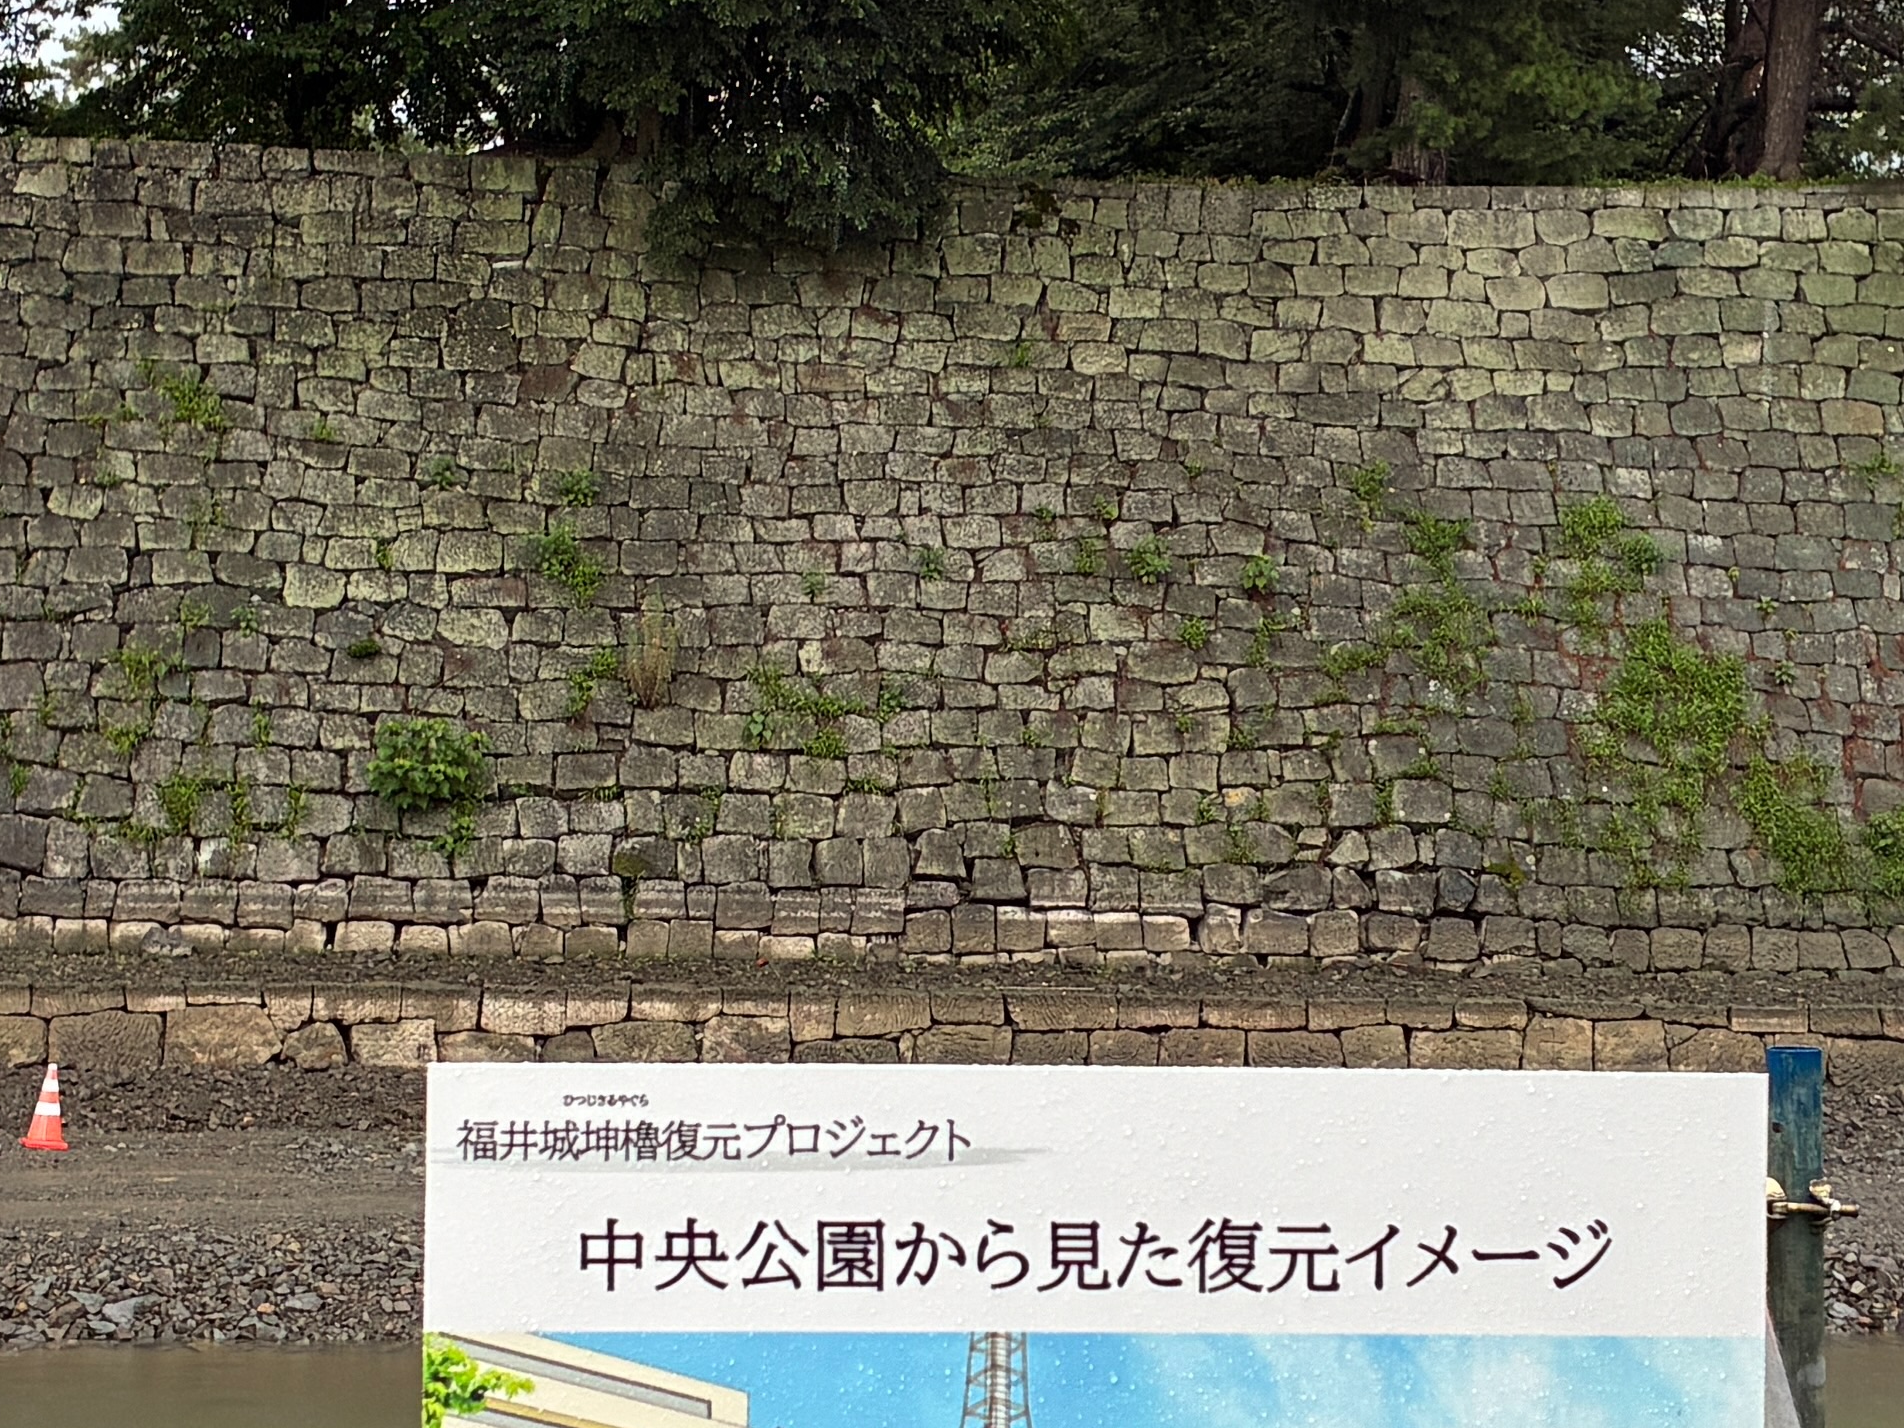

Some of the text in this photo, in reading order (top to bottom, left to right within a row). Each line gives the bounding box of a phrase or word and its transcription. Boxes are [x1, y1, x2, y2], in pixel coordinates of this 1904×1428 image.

[456, 1113, 972, 1162] 福井城坤櫓復元プロジェクト
[578, 1217, 1613, 1293] 中央公園から見た復元イメージ
